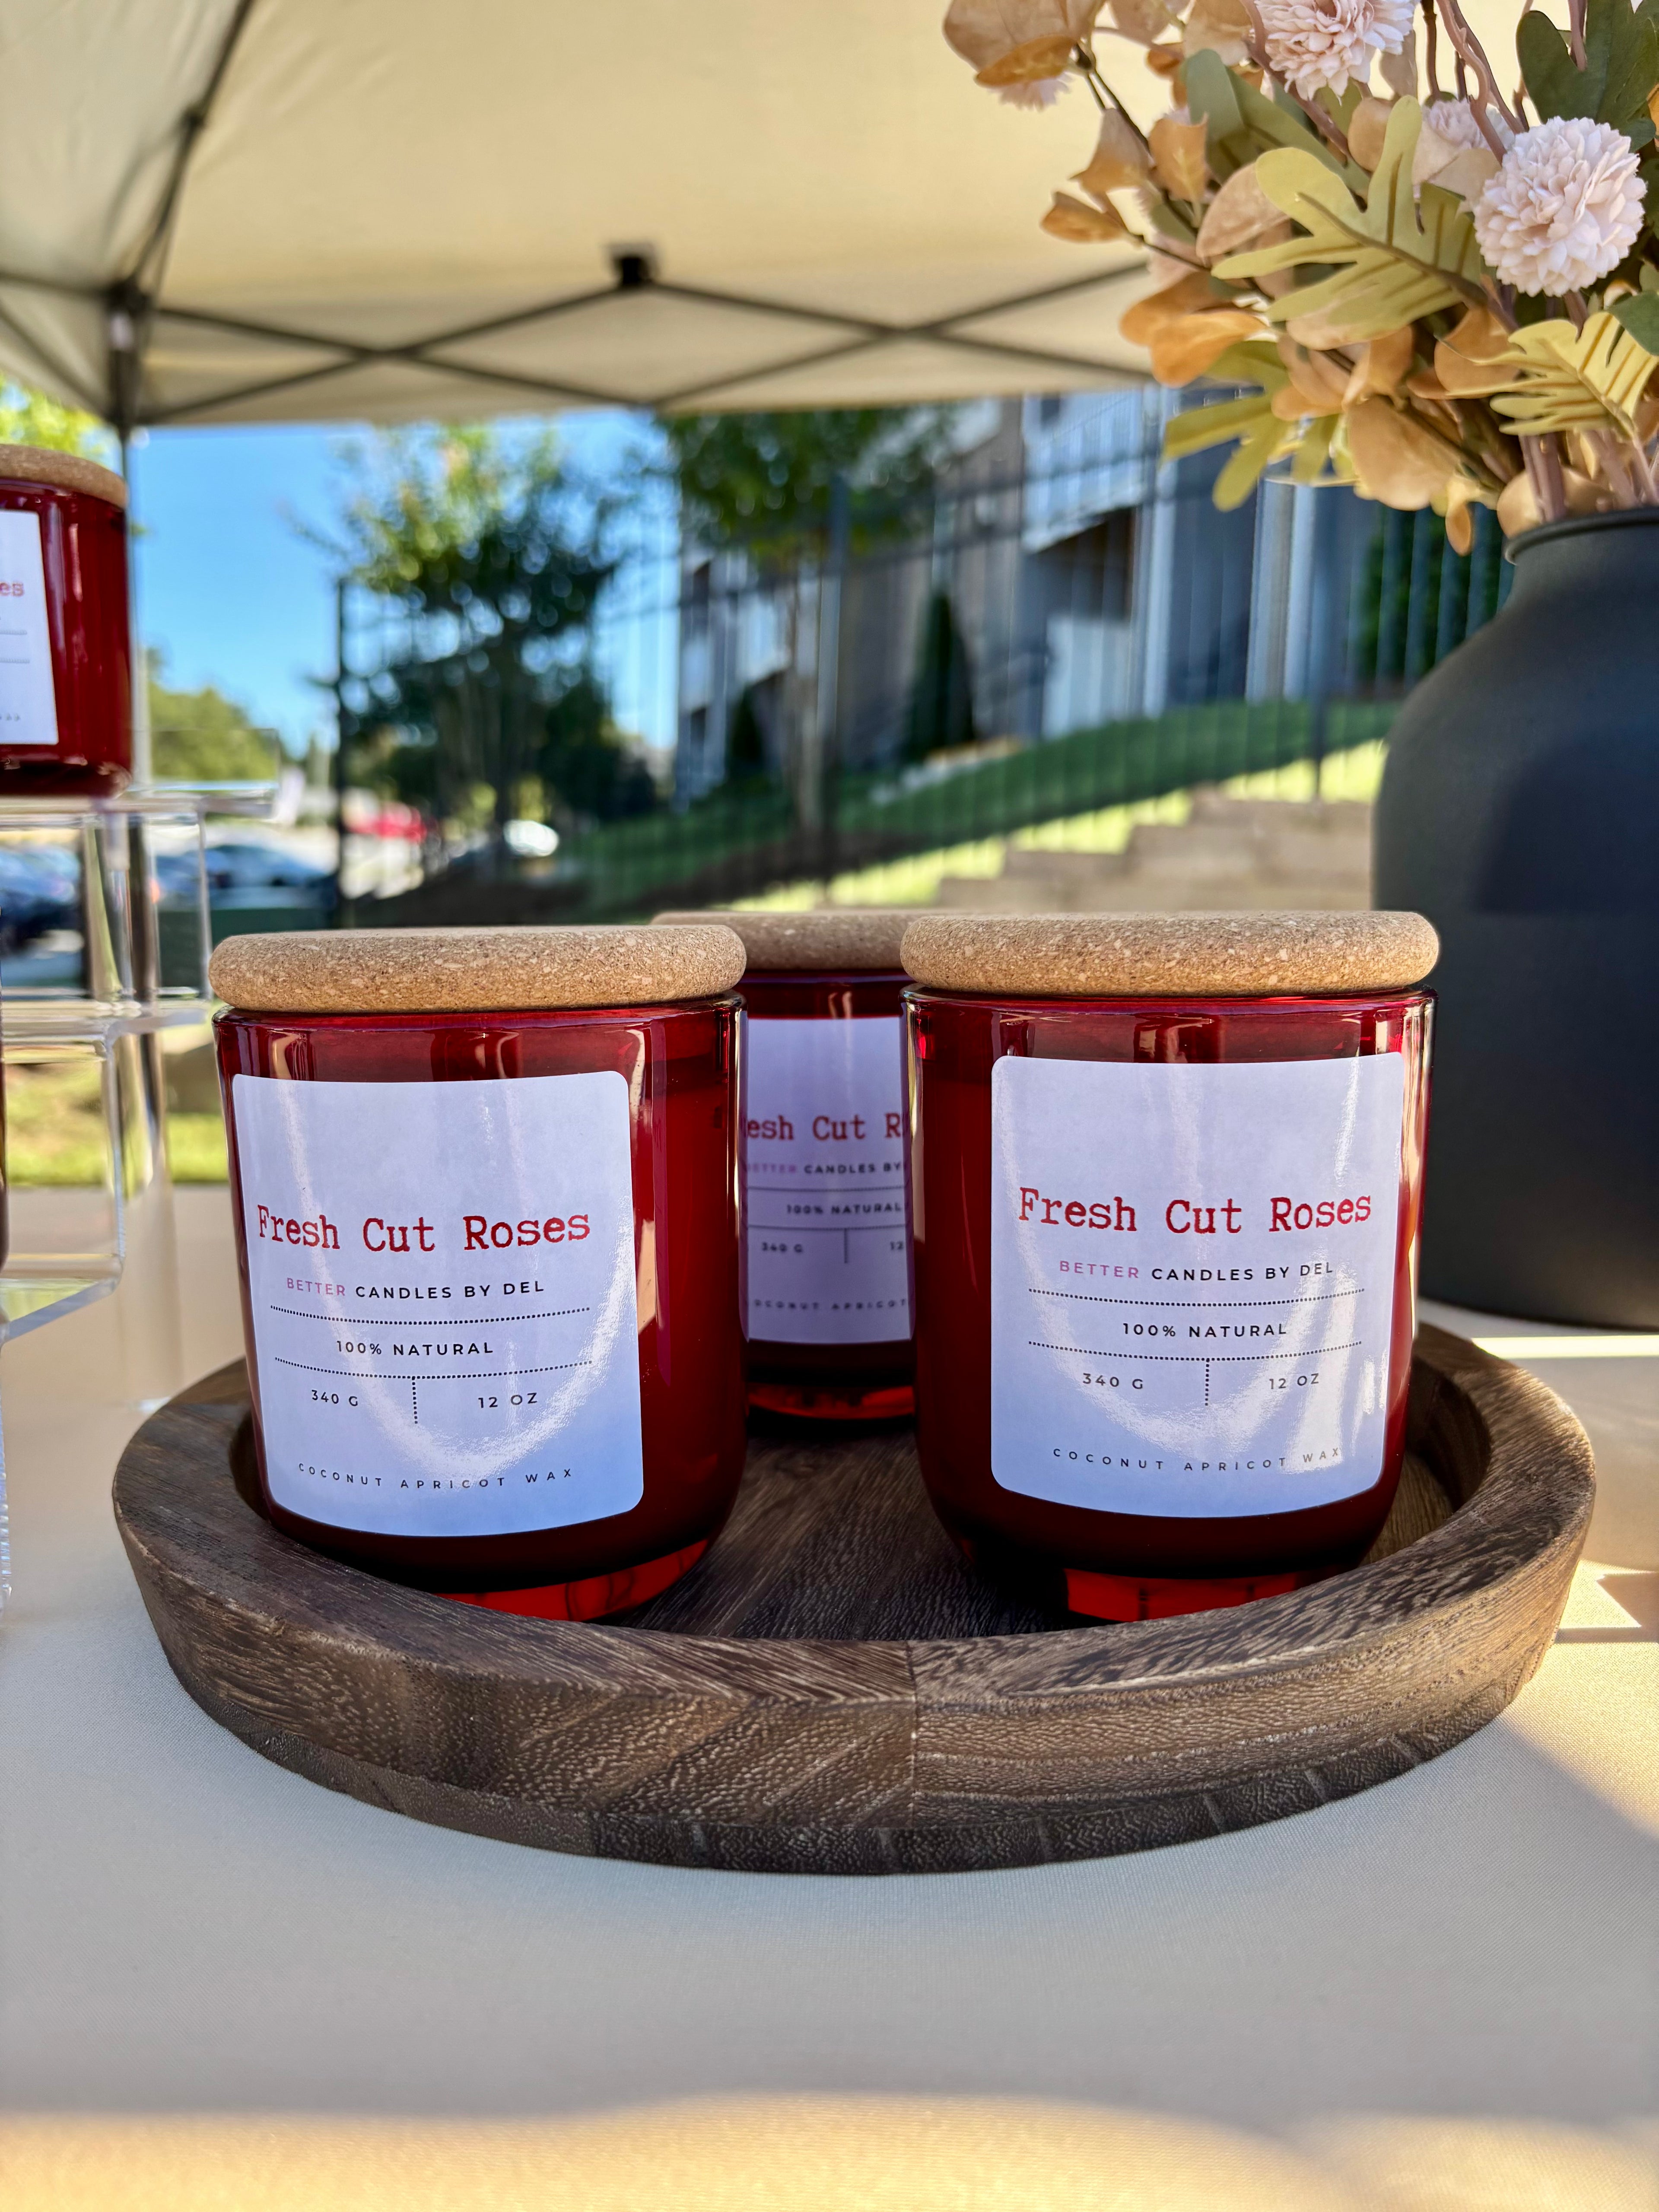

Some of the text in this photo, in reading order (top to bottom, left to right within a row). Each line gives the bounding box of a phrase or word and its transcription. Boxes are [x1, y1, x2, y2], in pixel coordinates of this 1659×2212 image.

[747, 1114, 794, 1141] esh
[812, 1115, 866, 1141] Cut
[804, 1164, 875, 1174] CANDLES
[884, 1162, 901, 1172] BY
[786, 1202, 902, 1215] 100% NATURAL
[1018, 1187, 1371, 1234] Fresh Cut Roses
[257, 1204, 591, 1252] Fresh Cut Roses
[1059, 1260, 1333, 1281] BETTER CANDLES BY DEL
[287, 1277, 544, 1299] BETTER CANDLES BY DEL
[1123, 1323, 1287, 1338] 100% NATURAL
[337, 1340, 493, 1356] 100% NATURAL
[1083, 1373, 1144, 1389] 340 G
[1269, 1373, 1319, 1390] 12 OZ
[311, 1389, 358, 1407] 340 G
[478, 1392, 538, 1408] 12 OZ
[1053, 1447, 1339, 1471] COCONUT APRICOT WAX
[299, 1463, 572, 1489] COCONUT APRICOT WAX
